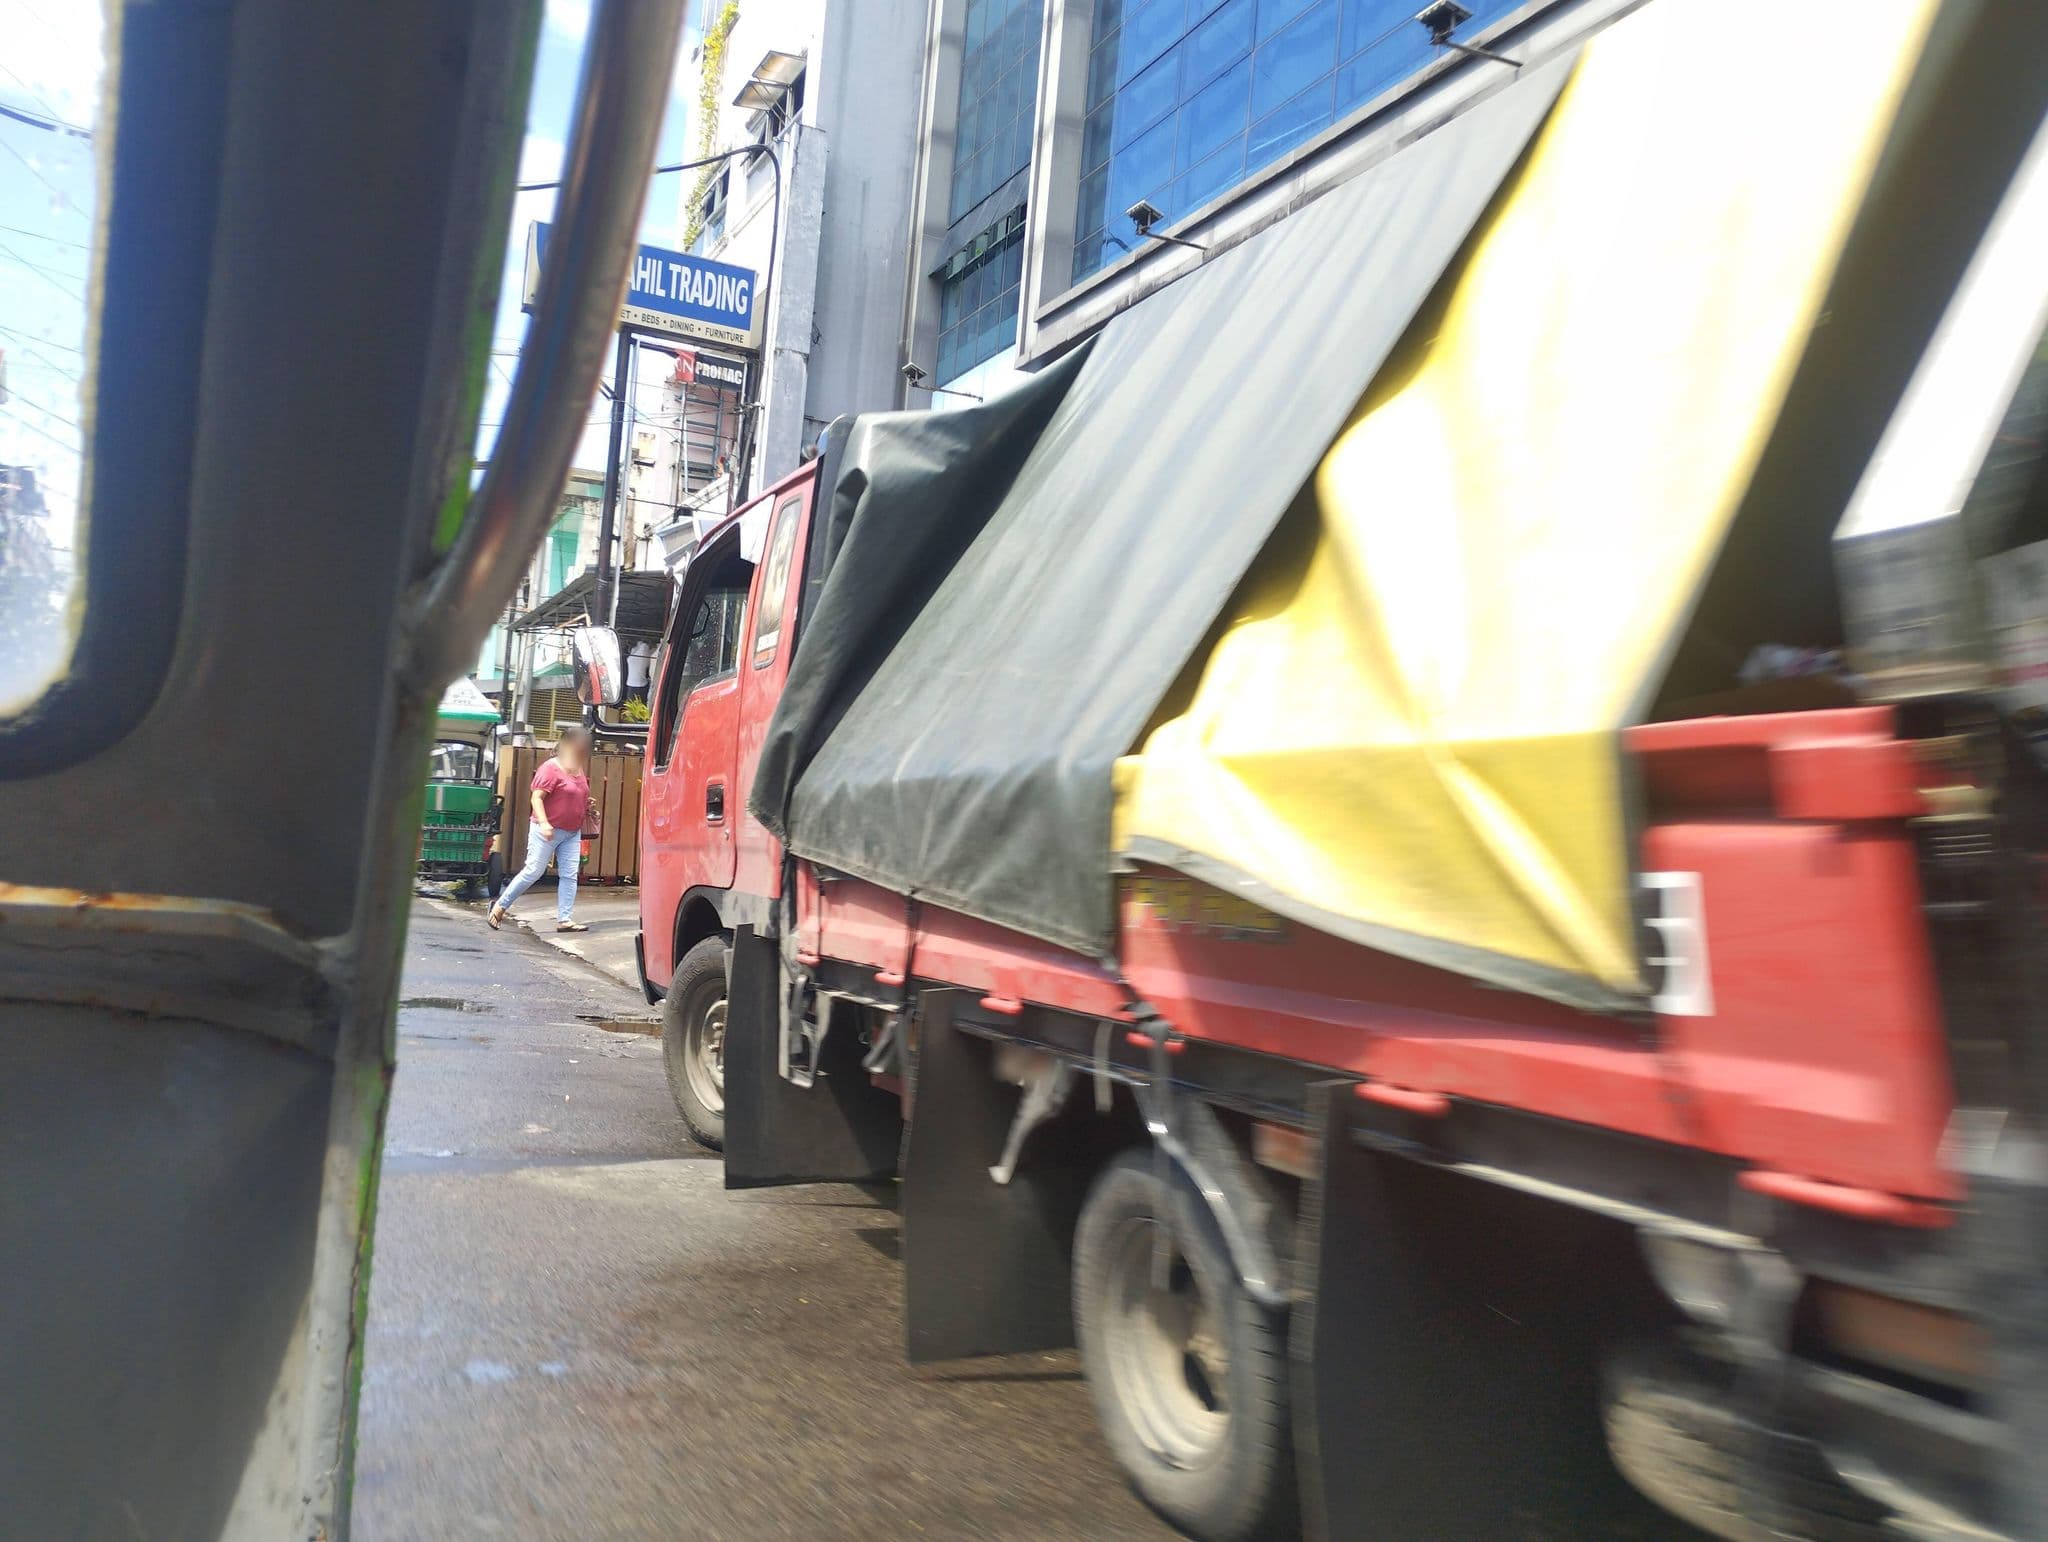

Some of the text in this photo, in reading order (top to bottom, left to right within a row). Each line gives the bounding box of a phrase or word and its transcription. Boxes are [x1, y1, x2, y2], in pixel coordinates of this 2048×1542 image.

[669, 263, 749, 316] TRADING
[641, 313, 660, 326] BEDS
[669, 319, 695, 333] DINING
[705, 327, 745, 344] FURNITURE
